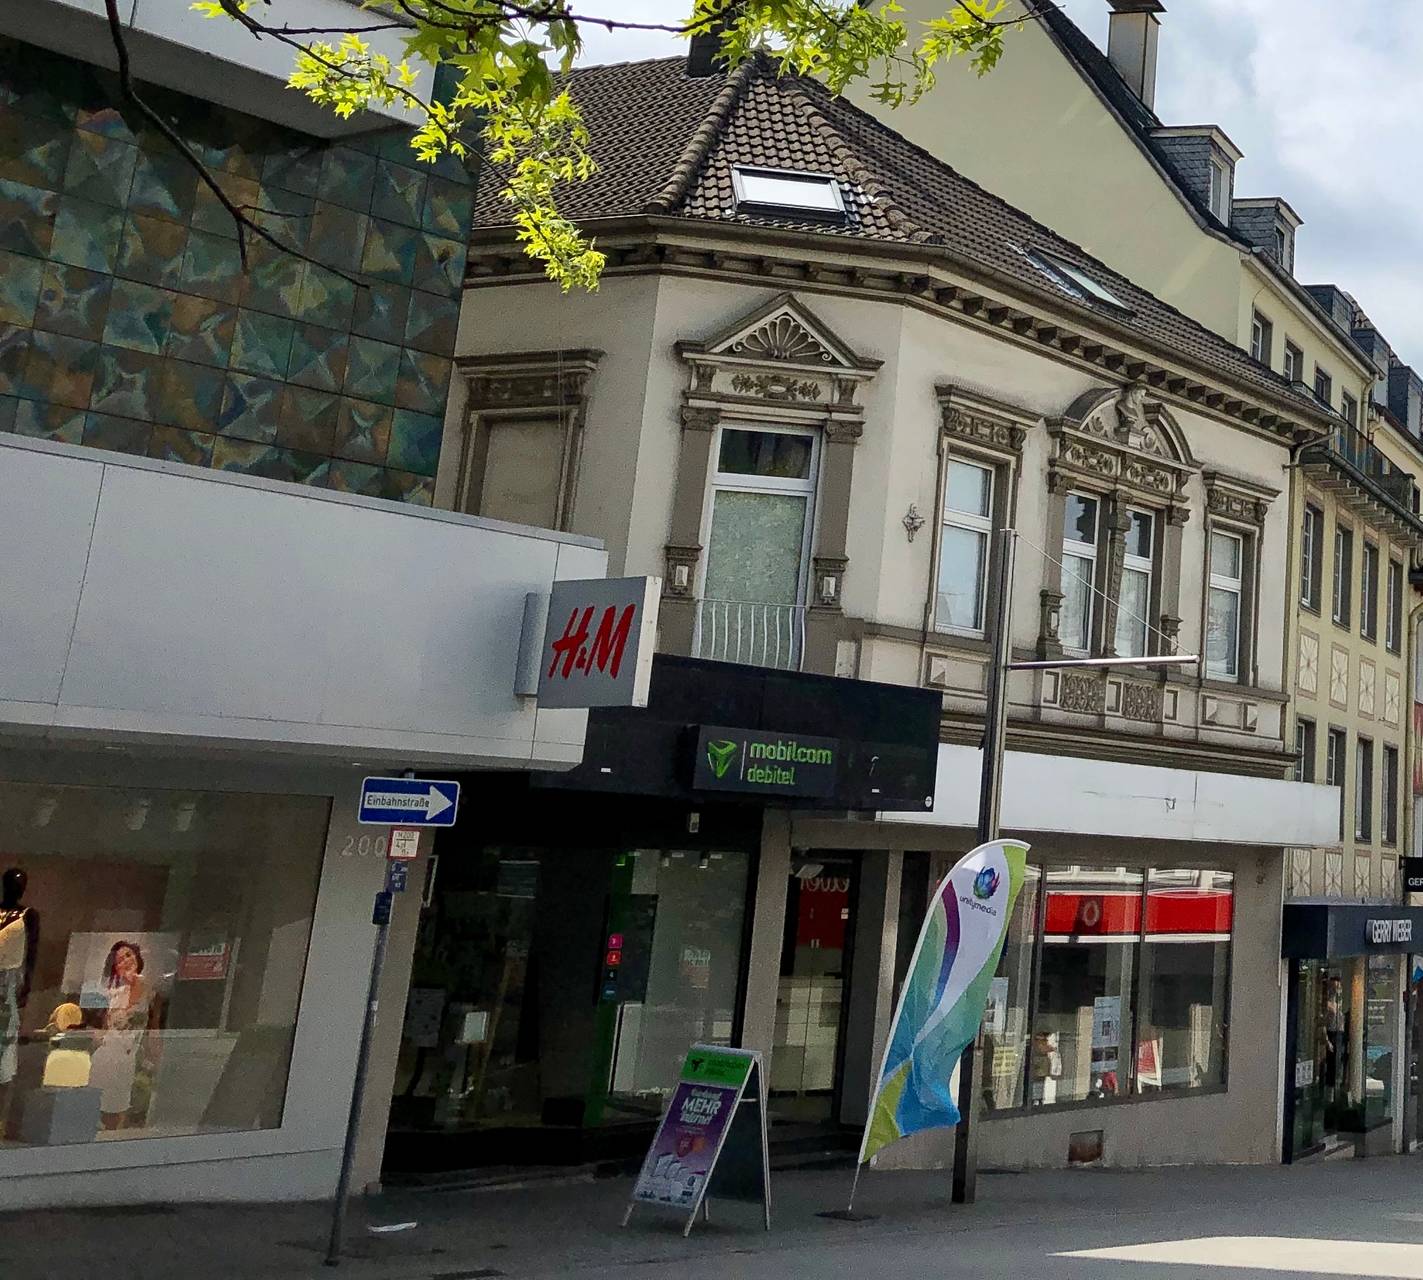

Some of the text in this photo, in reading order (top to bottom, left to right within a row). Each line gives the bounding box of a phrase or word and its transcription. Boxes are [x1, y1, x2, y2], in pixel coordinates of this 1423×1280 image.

[547, 603, 636, 680] H&M
[749, 739, 832, 765] mobilcom
[746, 763, 796, 786] debitel
[366, 794, 430, 808] Einbahnstraße
[959, 895, 997, 917] unitymedia
[1372, 919, 1412, 944] GERRY WEBER
[681, 1097, 722, 1115] MEHR
